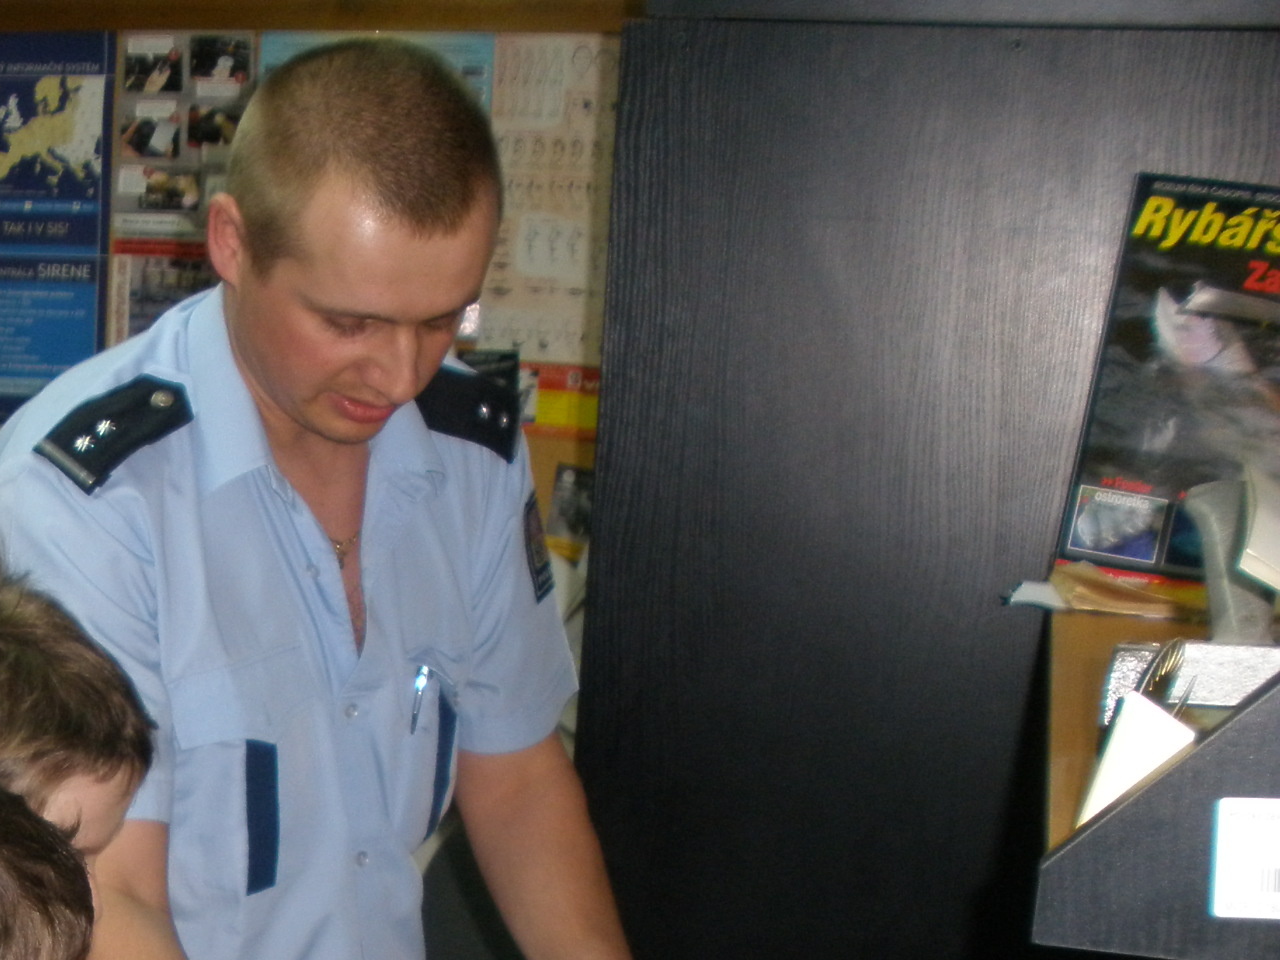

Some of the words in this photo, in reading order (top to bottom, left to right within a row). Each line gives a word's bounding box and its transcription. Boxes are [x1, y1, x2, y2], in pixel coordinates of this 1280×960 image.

[65, 61, 100, 73] SYSTÉM
[3, 220, 25, 233] TAK
[35, 221, 45, 233] V
[46, 221, 70, 234] SIS!
[38, 263, 91, 278] SIRENE
